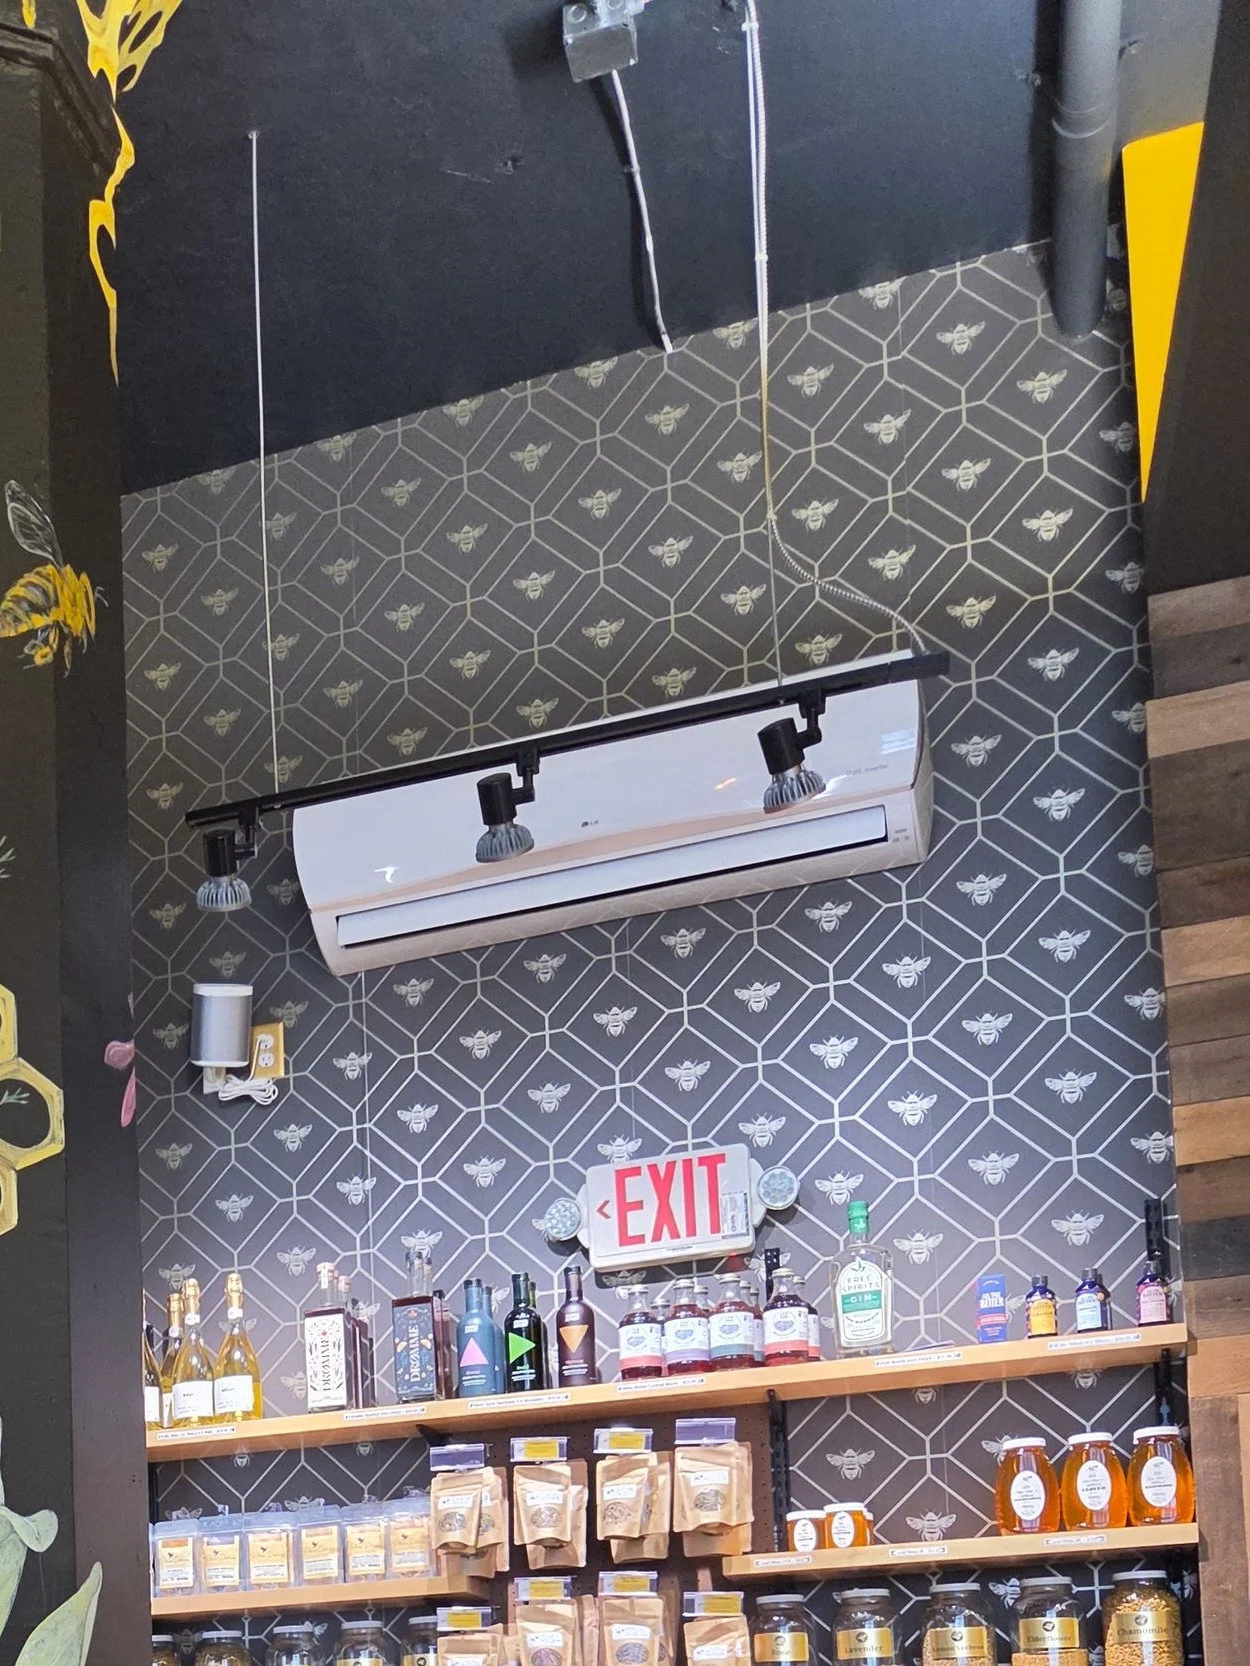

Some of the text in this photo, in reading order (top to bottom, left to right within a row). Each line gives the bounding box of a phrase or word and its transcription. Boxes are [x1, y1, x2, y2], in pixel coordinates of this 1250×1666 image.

[615, 1153, 726, 1247] EXIT
[1117, 1627, 1168, 1636] Chamomile
[845, 1645, 884, 1654] Lavender
